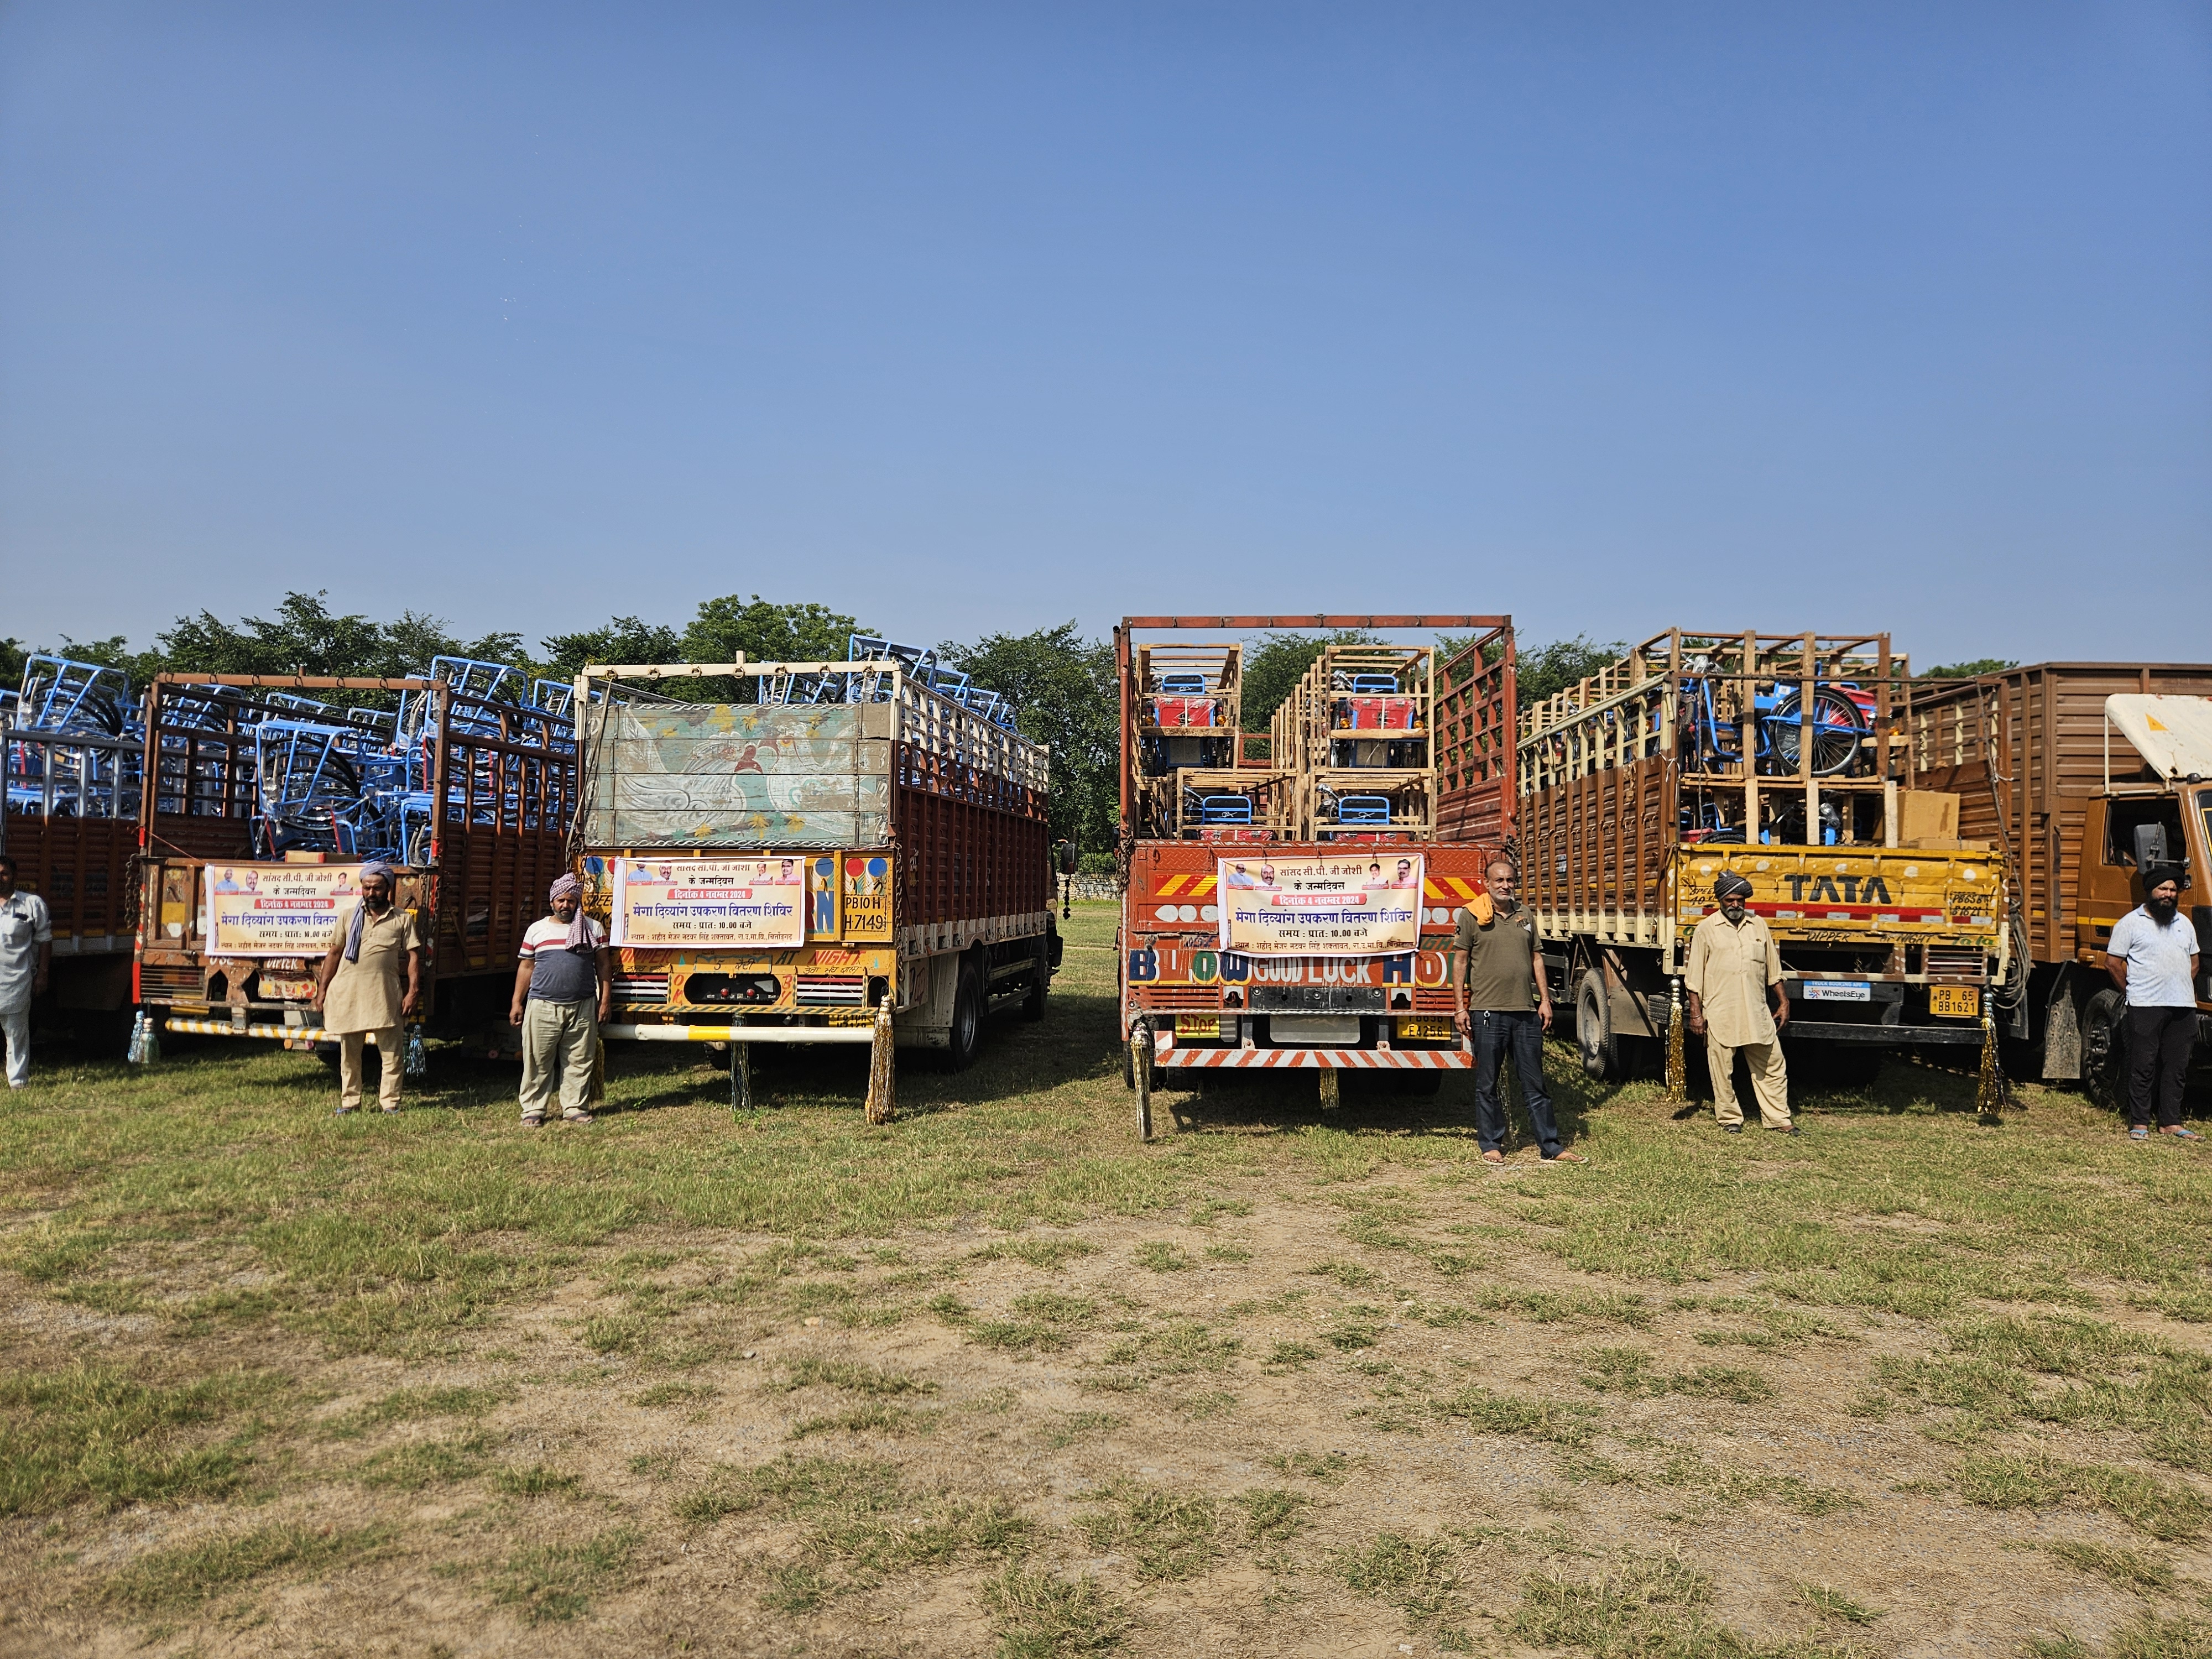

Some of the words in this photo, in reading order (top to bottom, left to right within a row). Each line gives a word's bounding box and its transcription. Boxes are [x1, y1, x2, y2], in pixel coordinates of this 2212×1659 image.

[1280, 867, 1301, 876] सांसद
[1329, 865, 1339, 875] जी
[1341, 864, 1362, 875] जोशी
[263, 874, 280, 882] सांसद
[305, 873, 314, 882] जी
[315, 872, 332, 882] जोशी
[688, 875, 696, 885] के
[699, 875, 734, 887] जन्मदिवस
[1293, 880, 1302, 891] के
[1306, 879, 1345, 892] जन्मदिवस
[1785, 874, 1892, 904] TATA
[273, 886, 280, 895] के
[283, 886, 316, 898] जन्मदिवस
[674, 889, 698, 899] दिनांक
[706, 890, 729, 899] नवम्बर
[730, 890, 745, 899] 2024
[1689, 888, 1714, 896] SPEE
[260, 899, 283, 909] दिनांक
[284, 900, 289, 908] 4
[290, 900, 312, 909] नवम्बर
[313, 900, 328, 908] 2024
[584, 894, 613, 908] SPEE
[1279, 895, 1306, 905] दिनांक
[1314, 896, 1341, 905] नवम्बर
[1342, 895, 1359, 904] 2024
[633, 902, 653, 916] मेगा
[655, 902, 688, 919] दिव्यांग
[690, 906, 727, 916] उपकरण
[729, 902, 761, 916] वितरण
[764, 902, 793, 917] शिविर
[1235, 907, 1256, 923] मेगा
[1259, 909, 1295, 926] दिव्यांग
[1297, 912, 1339, 924] उपकरण
[1342, 909, 1378, 924] वितरण
[1380, 907, 1413, 924] शिविर
[221, 912, 239, 926] मेगा
[242, 912, 274, 928] दिव्यांग
[276, 915, 311, 926] उपकरण
[739, 920, 752, 929] बजे
[651, 932, 666, 941] शहीद
[667, 932, 680, 940] मेजर
[699, 932, 709, 941] सिंह
[1353, 927, 1368, 937] बजे
[1807, 930, 1851, 943] DIPPER
[253, 940, 266, 948] मेजर
[1256, 941, 1271, 951] शहीद
[1274, 941, 1287, 950] मेजर
[1309, 941, 1320, 950] सिंह
[617, 948, 674, 963] DIPPER
[776, 950, 800, 965] AT
[807, 950, 867, 966] NIGHT
[1129, 949, 1253, 986] BLOW
[1253, 957, 1303, 983] GOOD
[1308, 956, 1372, 984] LUCK
[1821, 989, 1866, 1000] WheelsEye
[1939, 990, 1951, 1000] PB
[1961, 990, 1973, 1000] 65
[1938, 1001, 1975, 1013] BB1621
[1408, 1026, 1443, 1037] E4256
